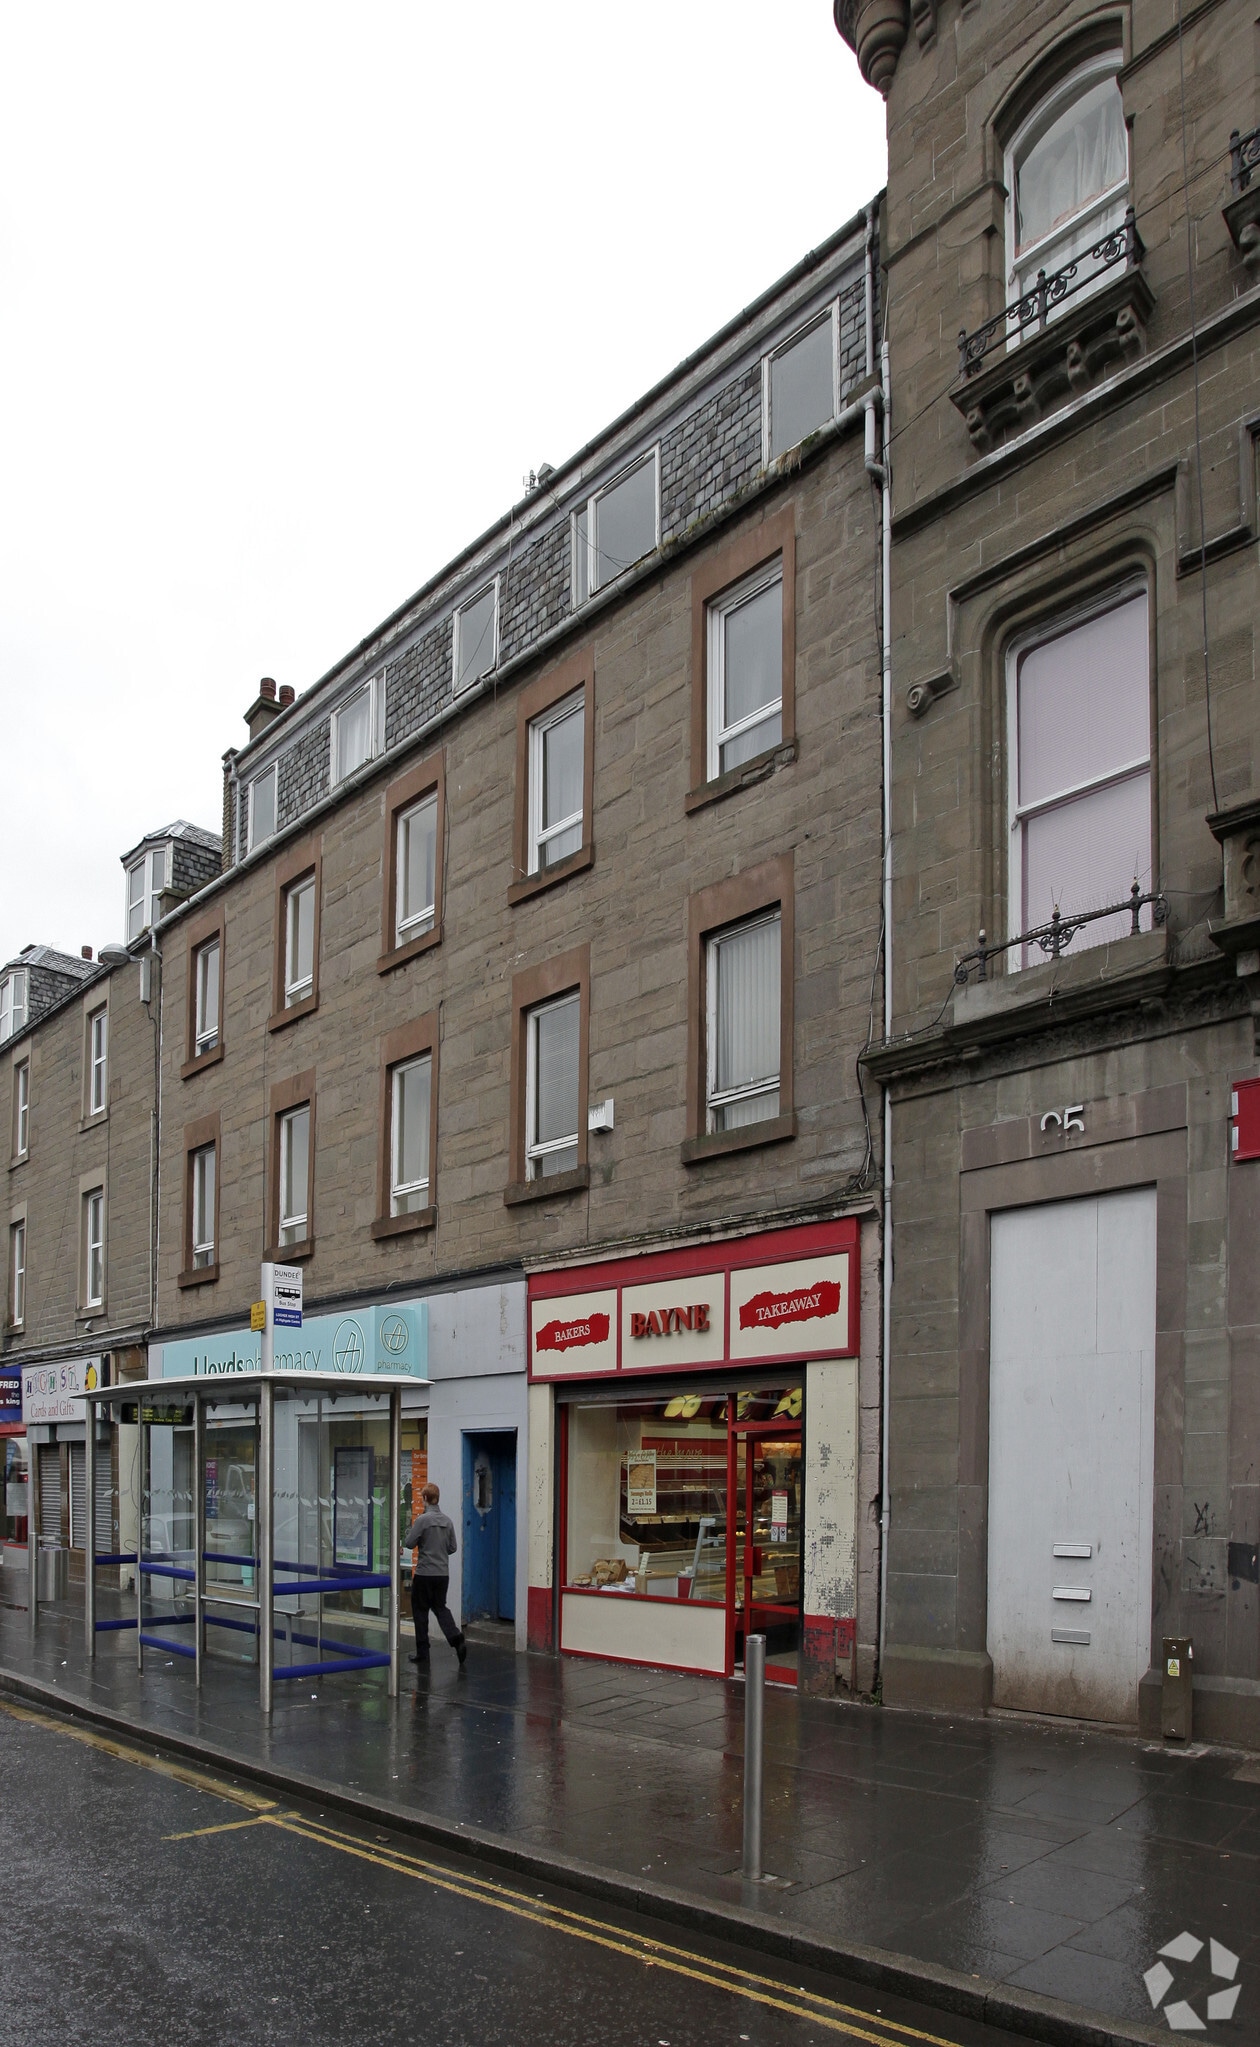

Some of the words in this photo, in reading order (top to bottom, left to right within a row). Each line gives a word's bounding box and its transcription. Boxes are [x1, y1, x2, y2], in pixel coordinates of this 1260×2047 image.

[274, 1270, 300, 1279] DUNDEE
[755, 1293, 822, 1321] TAKEAWAY
[630, 1304, 711, 1338] BAYNE
[554, 1324, 591, 1342] BAKERS
[194, 1348, 321, 1375] Lloydsphrmacy
[377, 1358, 412, 1371] pharmacy
[5, 1398, 20, 1406] king
[31, 1401, 47, 1418] Cards
[48, 1400, 58, 1416] and
[60, 1399, 74, 1416] Gifts
